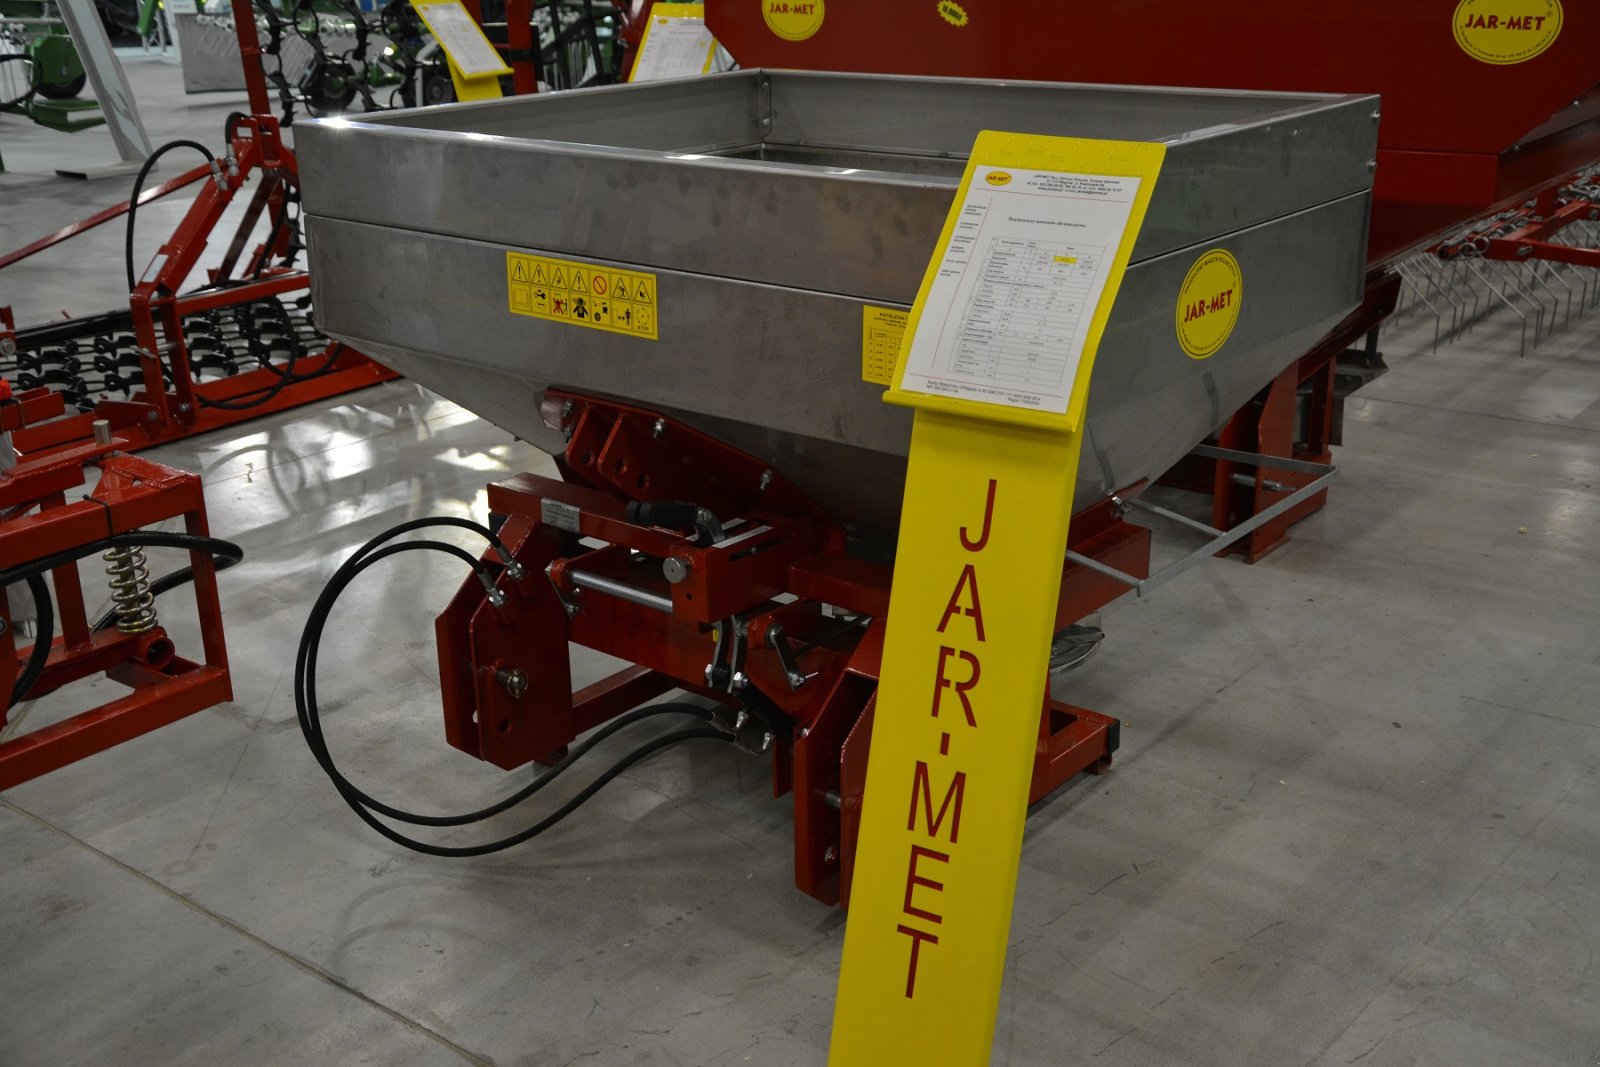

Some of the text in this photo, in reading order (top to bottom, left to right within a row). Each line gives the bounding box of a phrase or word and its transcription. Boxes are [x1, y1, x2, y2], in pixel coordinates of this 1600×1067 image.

[770, 2, 815, 16] JAR-MET
[1465, 13, 1546, 31] JAR-MET
[1184, 289, 1233, 323] JAR-MET
[897, 479, 998, 1000] JAR-MET
